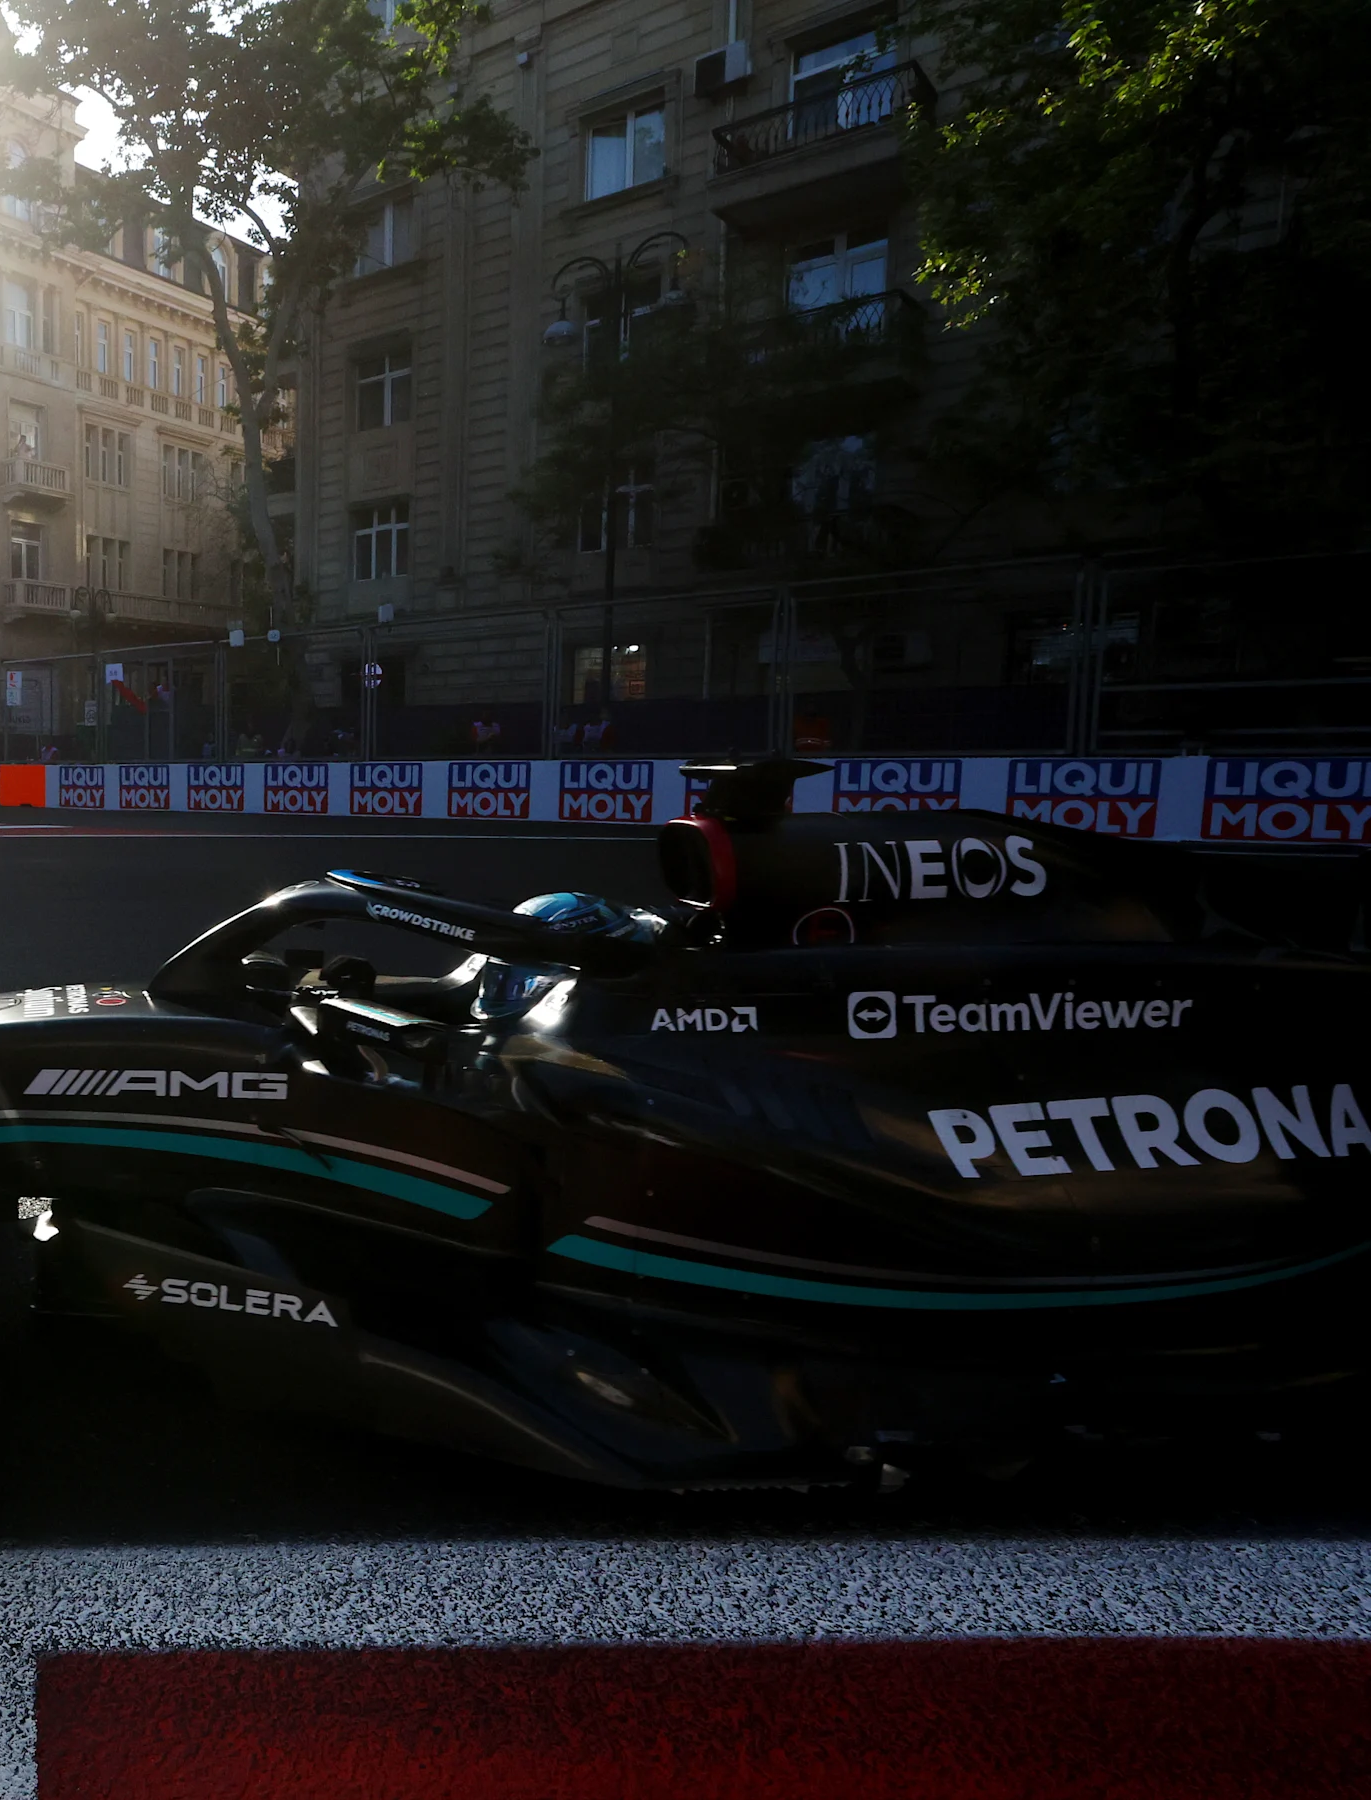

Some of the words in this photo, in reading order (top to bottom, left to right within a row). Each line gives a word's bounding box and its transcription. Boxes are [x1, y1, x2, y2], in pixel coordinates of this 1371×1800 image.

[60, 766, 103, 786] LIQUI
[120, 766, 168, 787] LIQUI
[188, 765, 242, 787] LIQUI
[266, 764, 326, 788] LIQUI
[353, 764, 419, 789] LIQUI
[451, 763, 526, 789] LIQUI
[564, 762, 650, 791] LIQUI
[839, 761, 955, 794] LIQUI
[1014, 761, 1154, 797] LIQUI
[60, 788, 104, 807] MOLY
[120, 788, 169, 809] MOLY
[188, 788, 243, 809] MOLY
[266, 789, 327, 812] MOLY
[352, 790, 421, 815] MOLY
[450, 790, 529, 816] MOLY
[561, 792, 652, 819] MOLY
[1013, 800, 1156, 834] MOLY
[1209, 803, 1371, 840] MOLY
[833, 834, 1048, 903] INEOS
[372, 904, 476, 941] CROWDSTRIKE
[66, 985, 90, 1014] PETRONAS
[903, 991, 1193, 1034] TeamViewer
[650, 1007, 730, 1033] AMD
[106, 1069, 289, 1100] AMG
[160, 1277, 339, 1328] SOLERA
